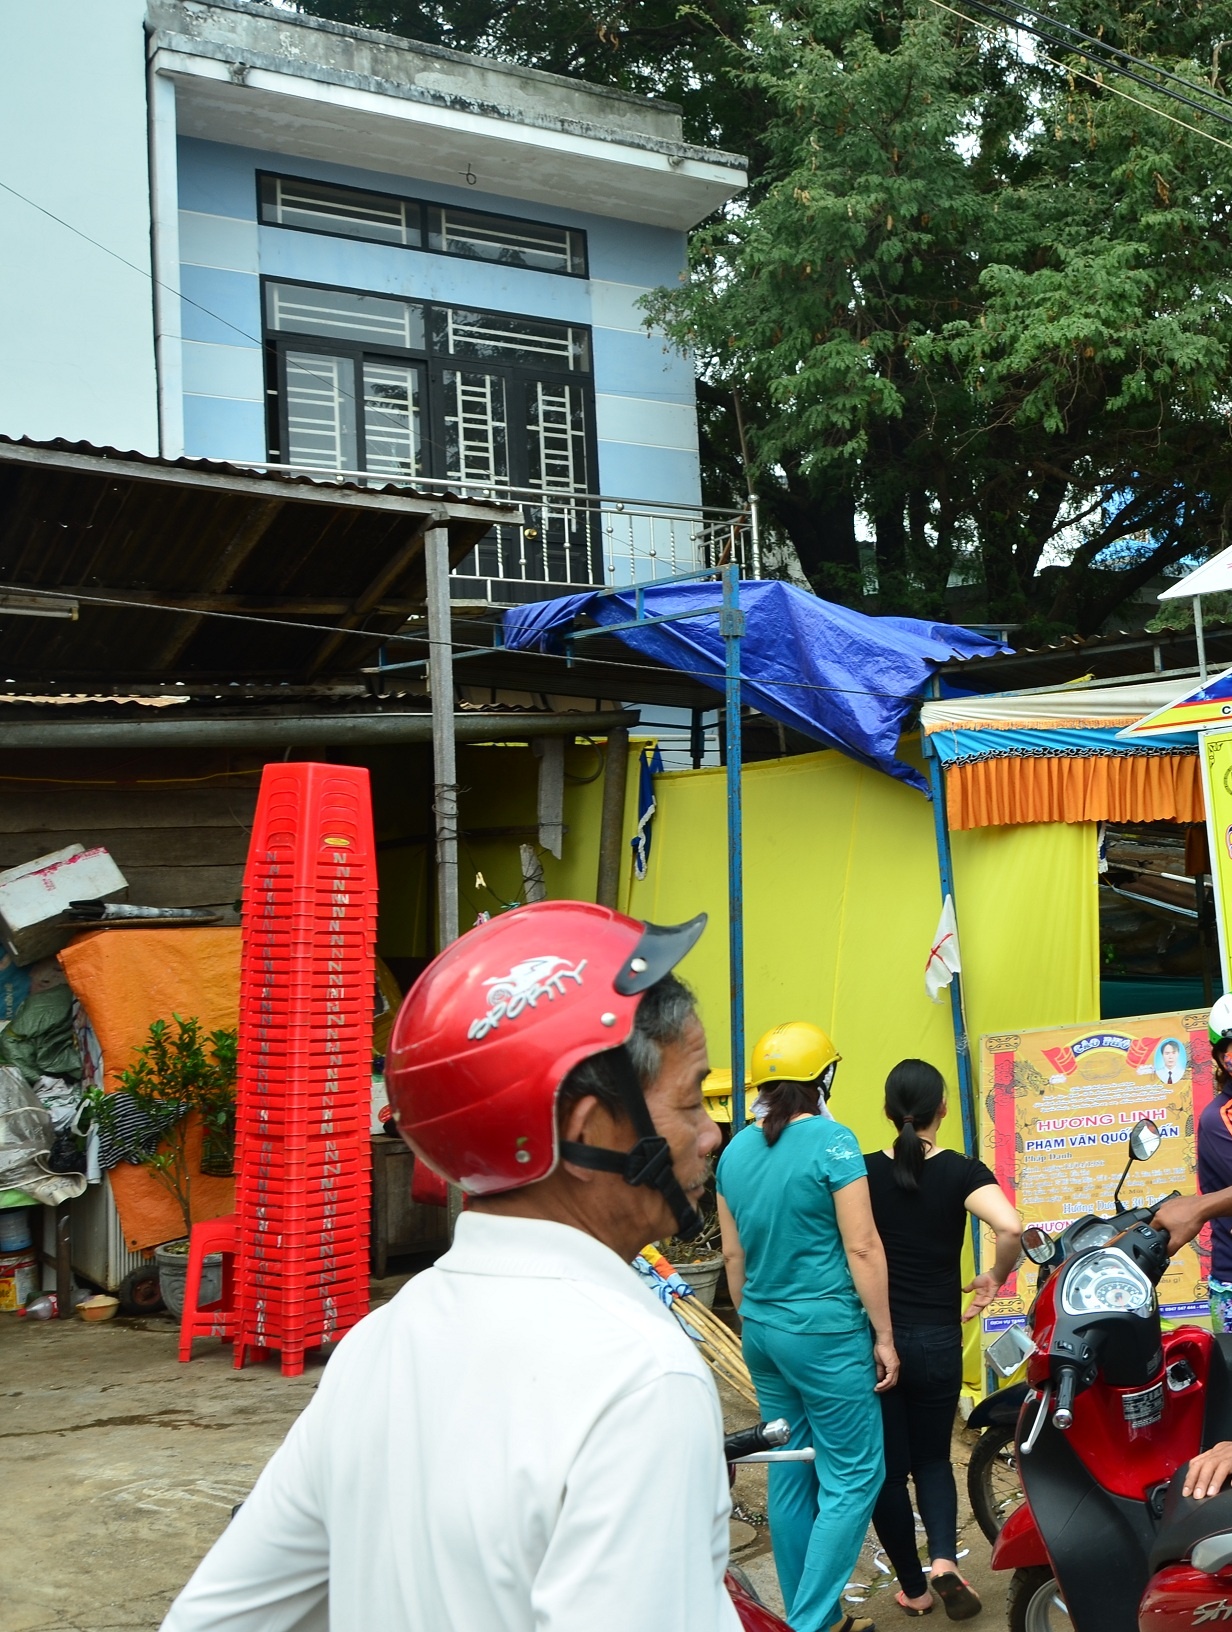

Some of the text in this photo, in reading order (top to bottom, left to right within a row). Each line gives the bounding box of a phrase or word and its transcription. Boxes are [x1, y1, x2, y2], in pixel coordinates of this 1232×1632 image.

[1037, 1108, 1167, 1132] HƯƠNG LINH
[1026, 1138, 1065, 1151] PHẠM
[1069, 1132, 1097, 1147] VĂN
[1101, 1127, 1132, 1143] QUỐ
[1132, 1196, 1144, 1207] 30
